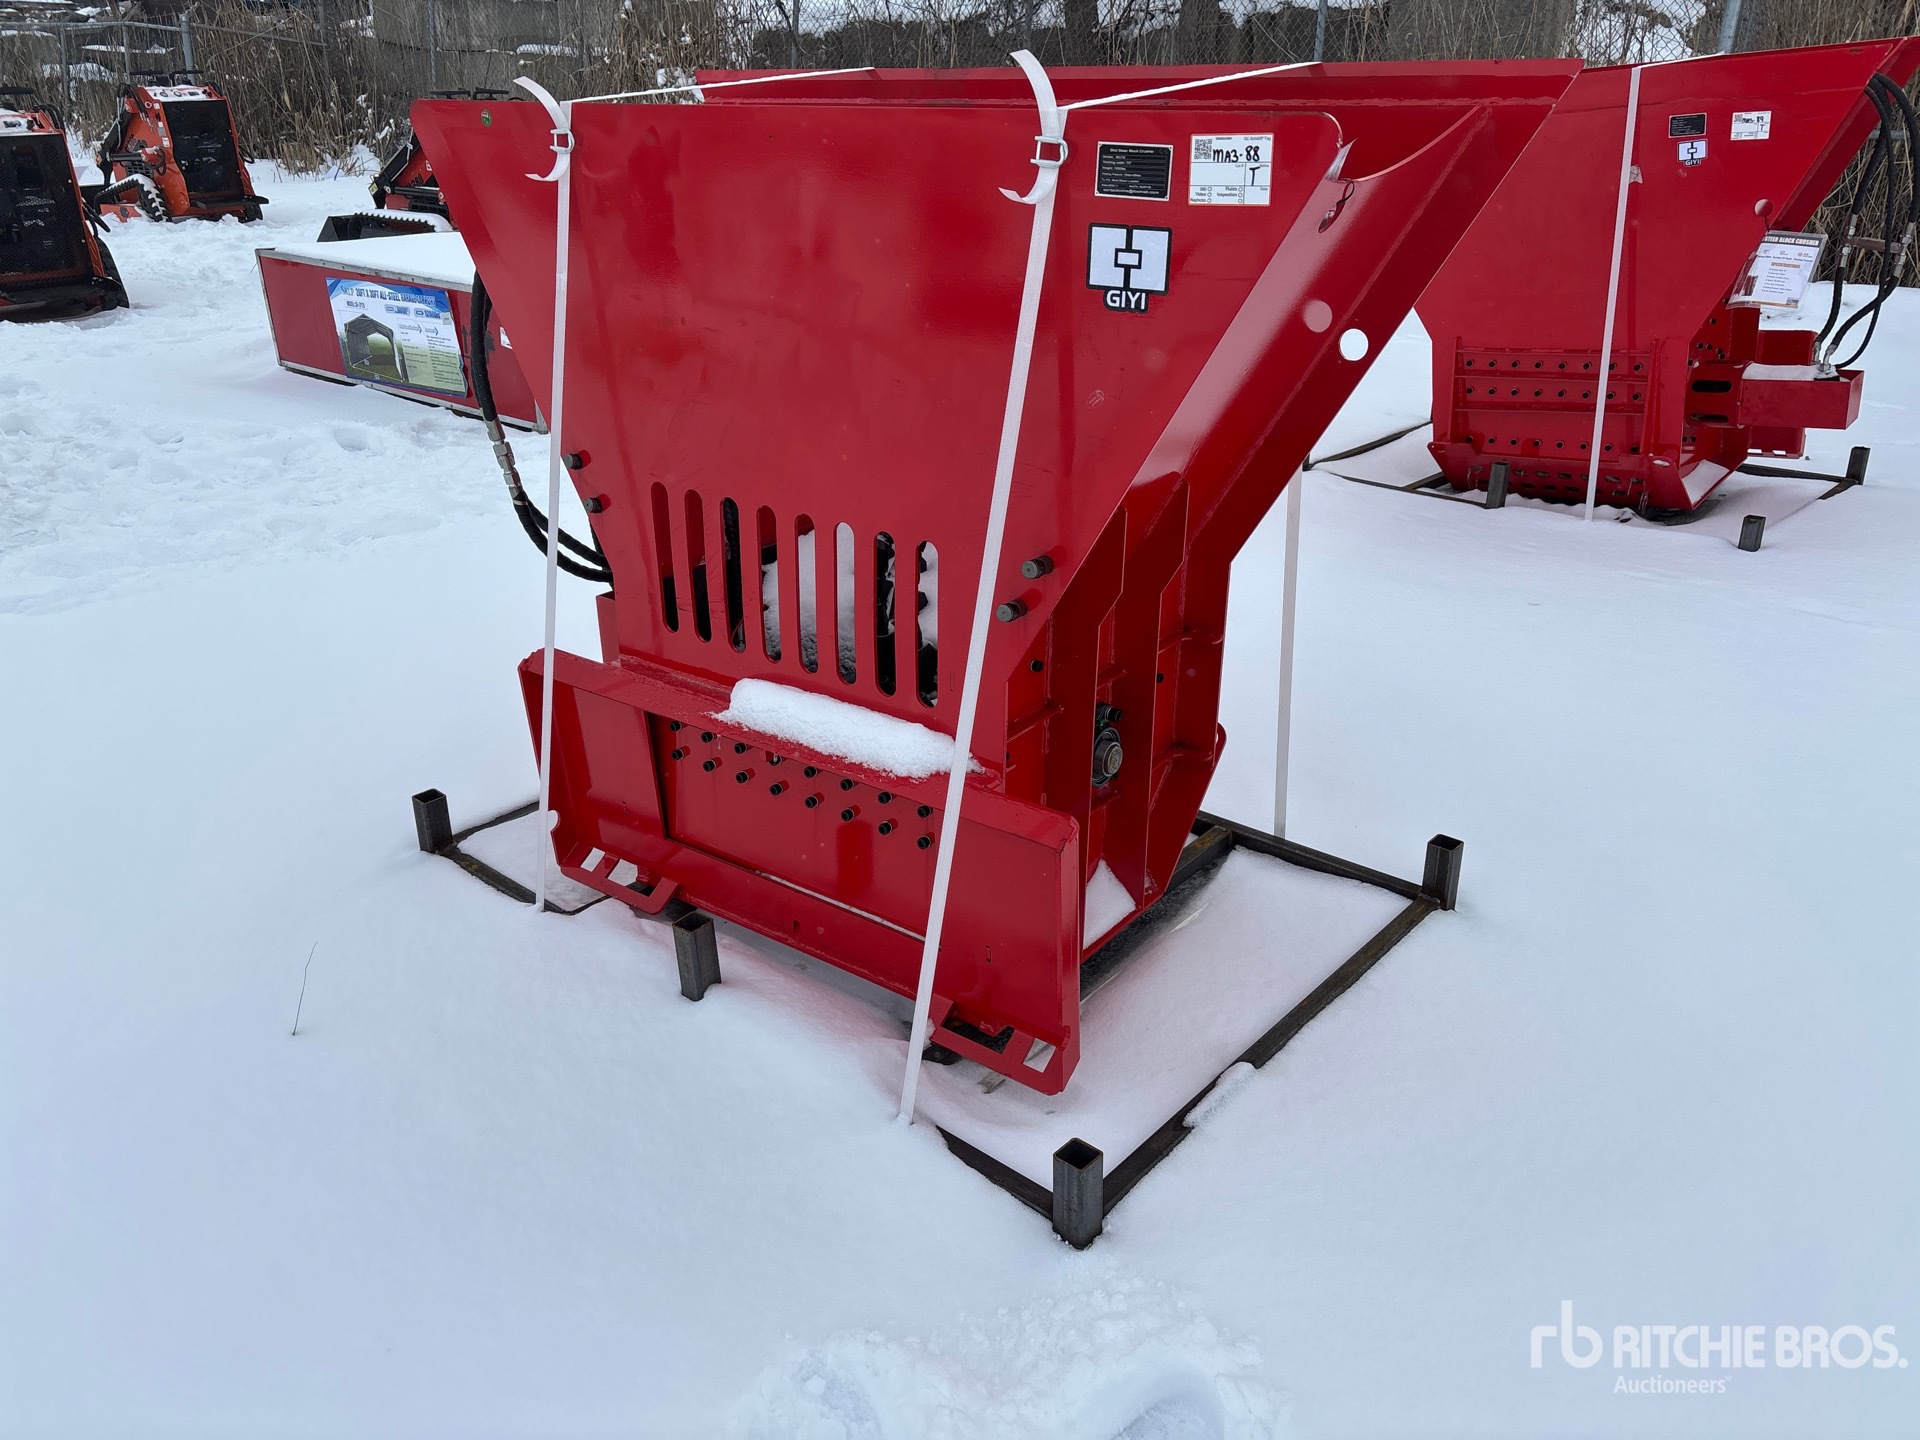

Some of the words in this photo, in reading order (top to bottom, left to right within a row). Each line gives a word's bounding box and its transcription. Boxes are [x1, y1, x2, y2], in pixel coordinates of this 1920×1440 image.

[1685, 158, 1700, 166] GIYI
[1249, 166, 1261, 186] T
[1795, 238, 1820, 246] CRUSHER
[1106, 290, 1146, 310] GIYI
